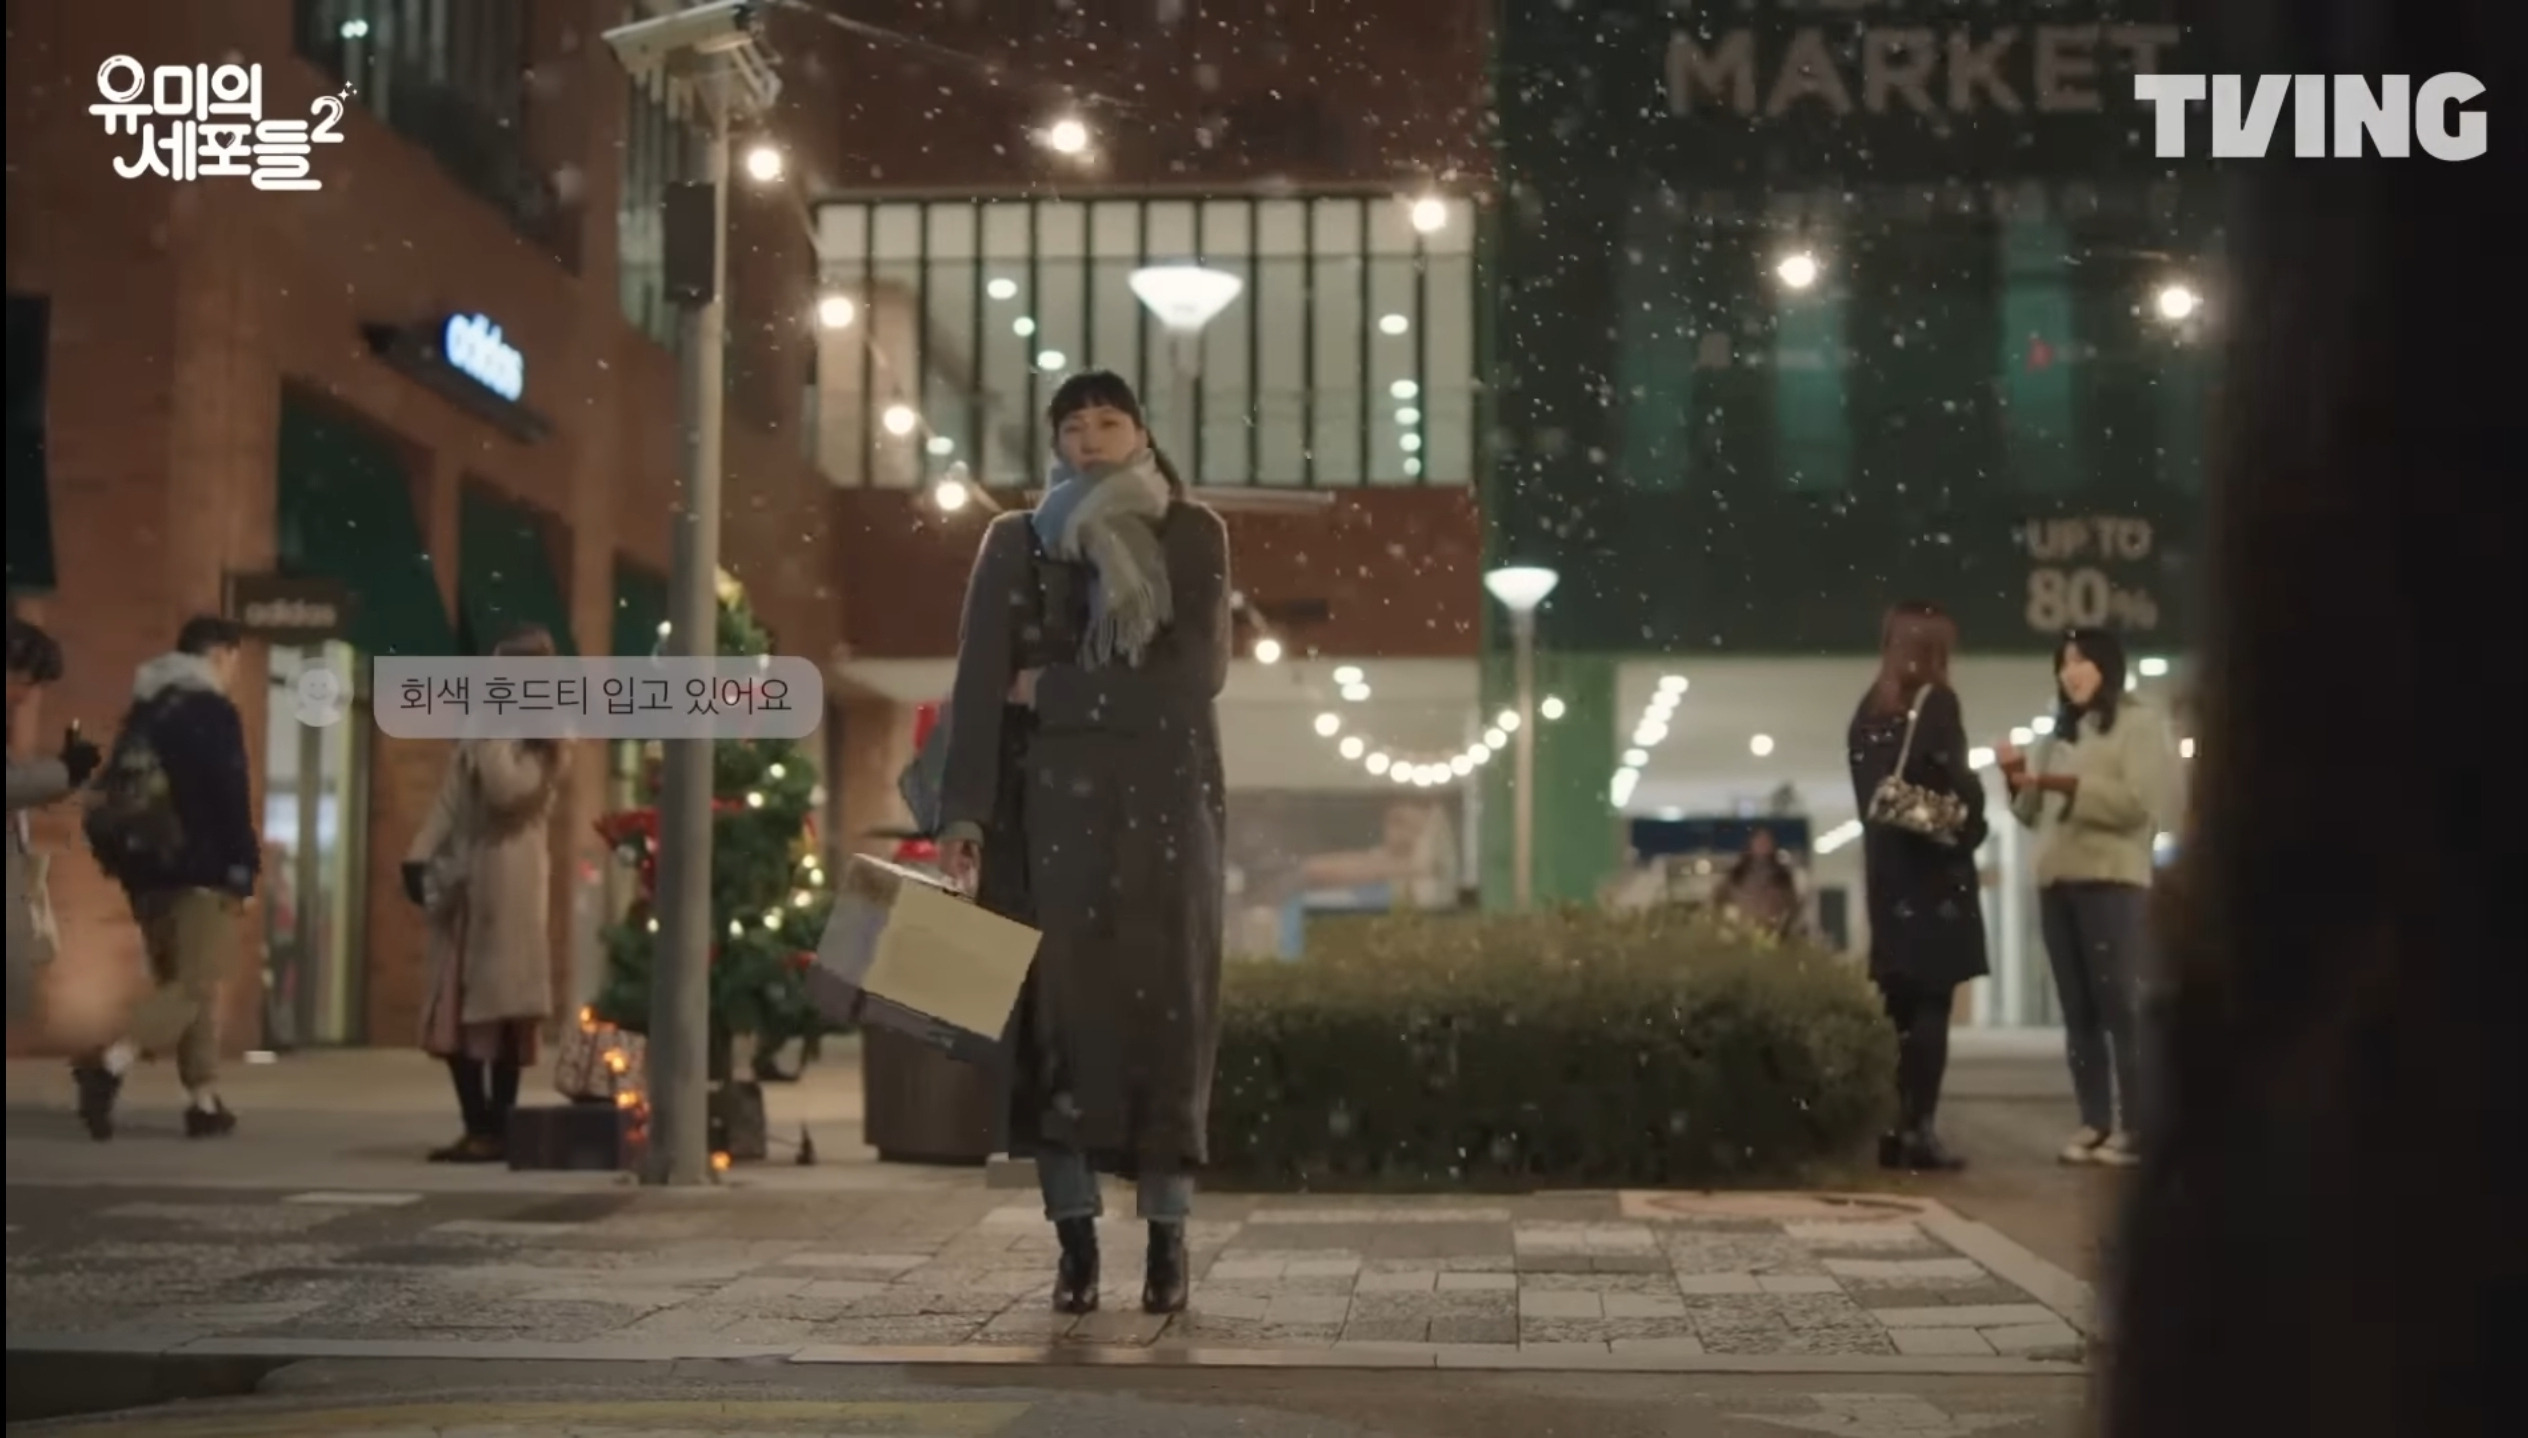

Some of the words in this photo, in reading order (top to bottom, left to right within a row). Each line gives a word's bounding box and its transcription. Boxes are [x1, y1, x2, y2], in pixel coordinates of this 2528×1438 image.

[1667, 23, 2180, 115] MARKET
[2027, 516, 2088, 560] UP
[2092, 515, 2152, 560] TO
[2026, 567, 2158, 632] 80%
